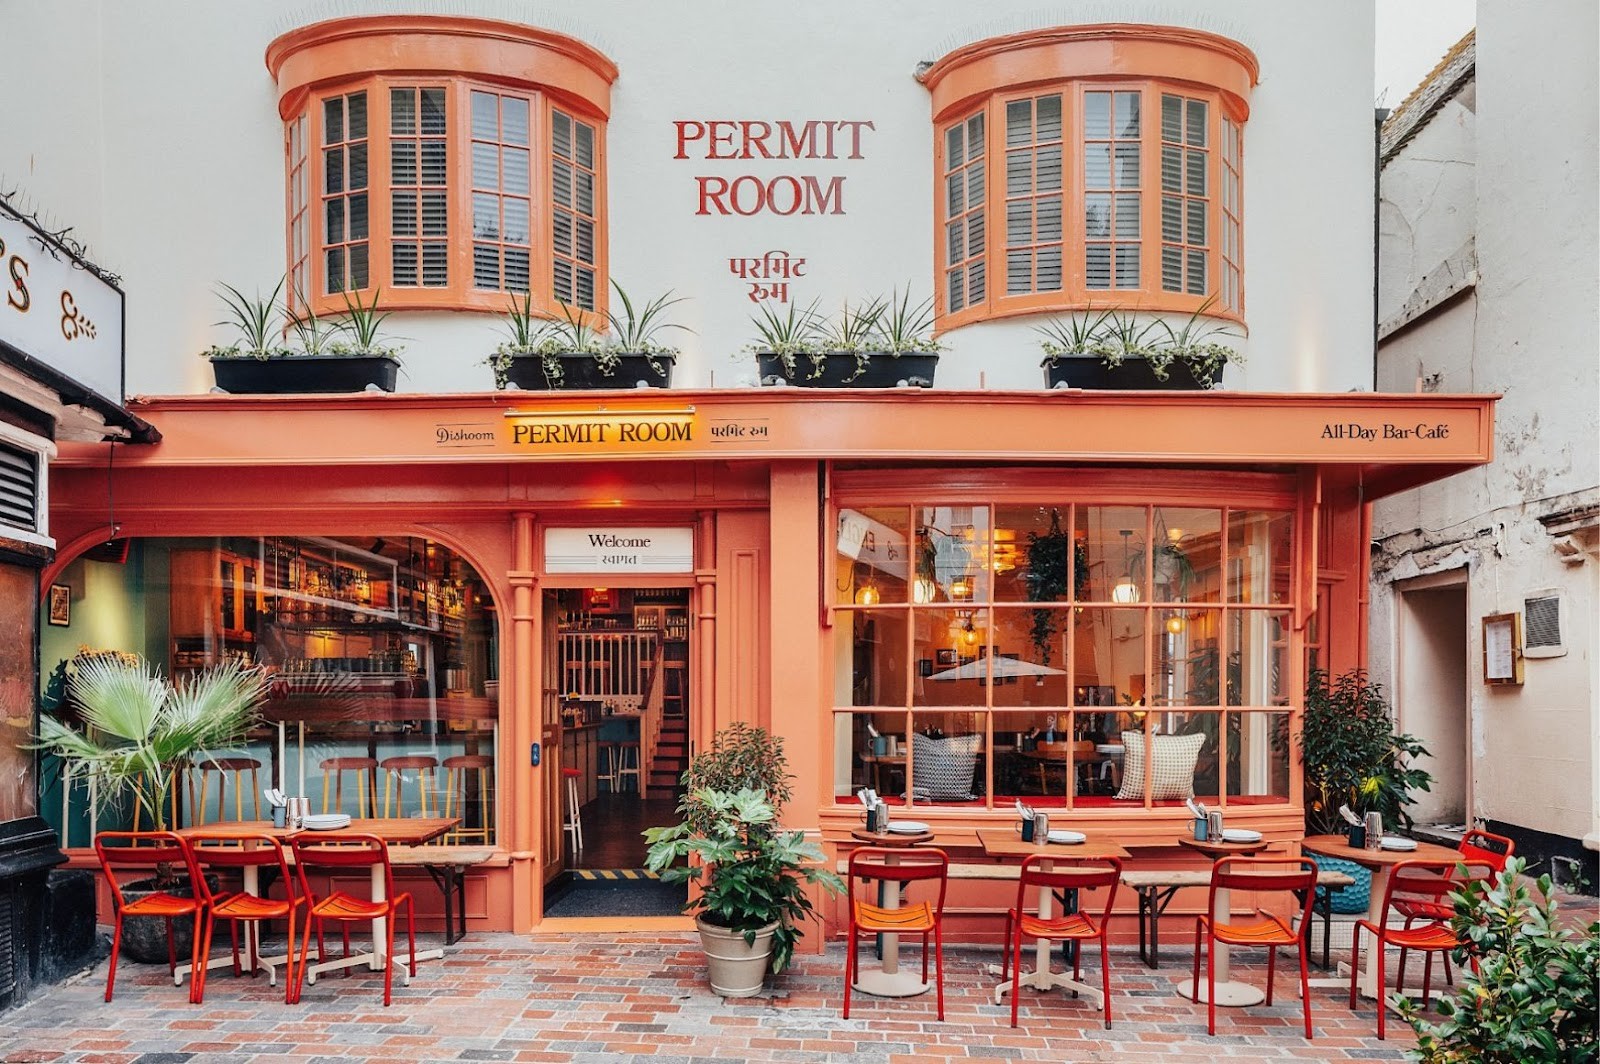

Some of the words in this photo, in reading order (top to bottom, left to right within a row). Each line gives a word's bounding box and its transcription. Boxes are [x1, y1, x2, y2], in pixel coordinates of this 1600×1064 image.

[672, 120, 876, 160] PERMIT
[694, 175, 847, 216] ROOM
[727, 250, 808, 279] परमिट
[436, 427, 495, 444] Dishoom
[513, 422, 612, 445] PERMIT
[619, 422, 693, 443] ROOM
[1321, 423, 1378, 442] All-Day
[1383, 423, 1450, 440] Bar-Café
[588, 534, 651, 548] Welcome
